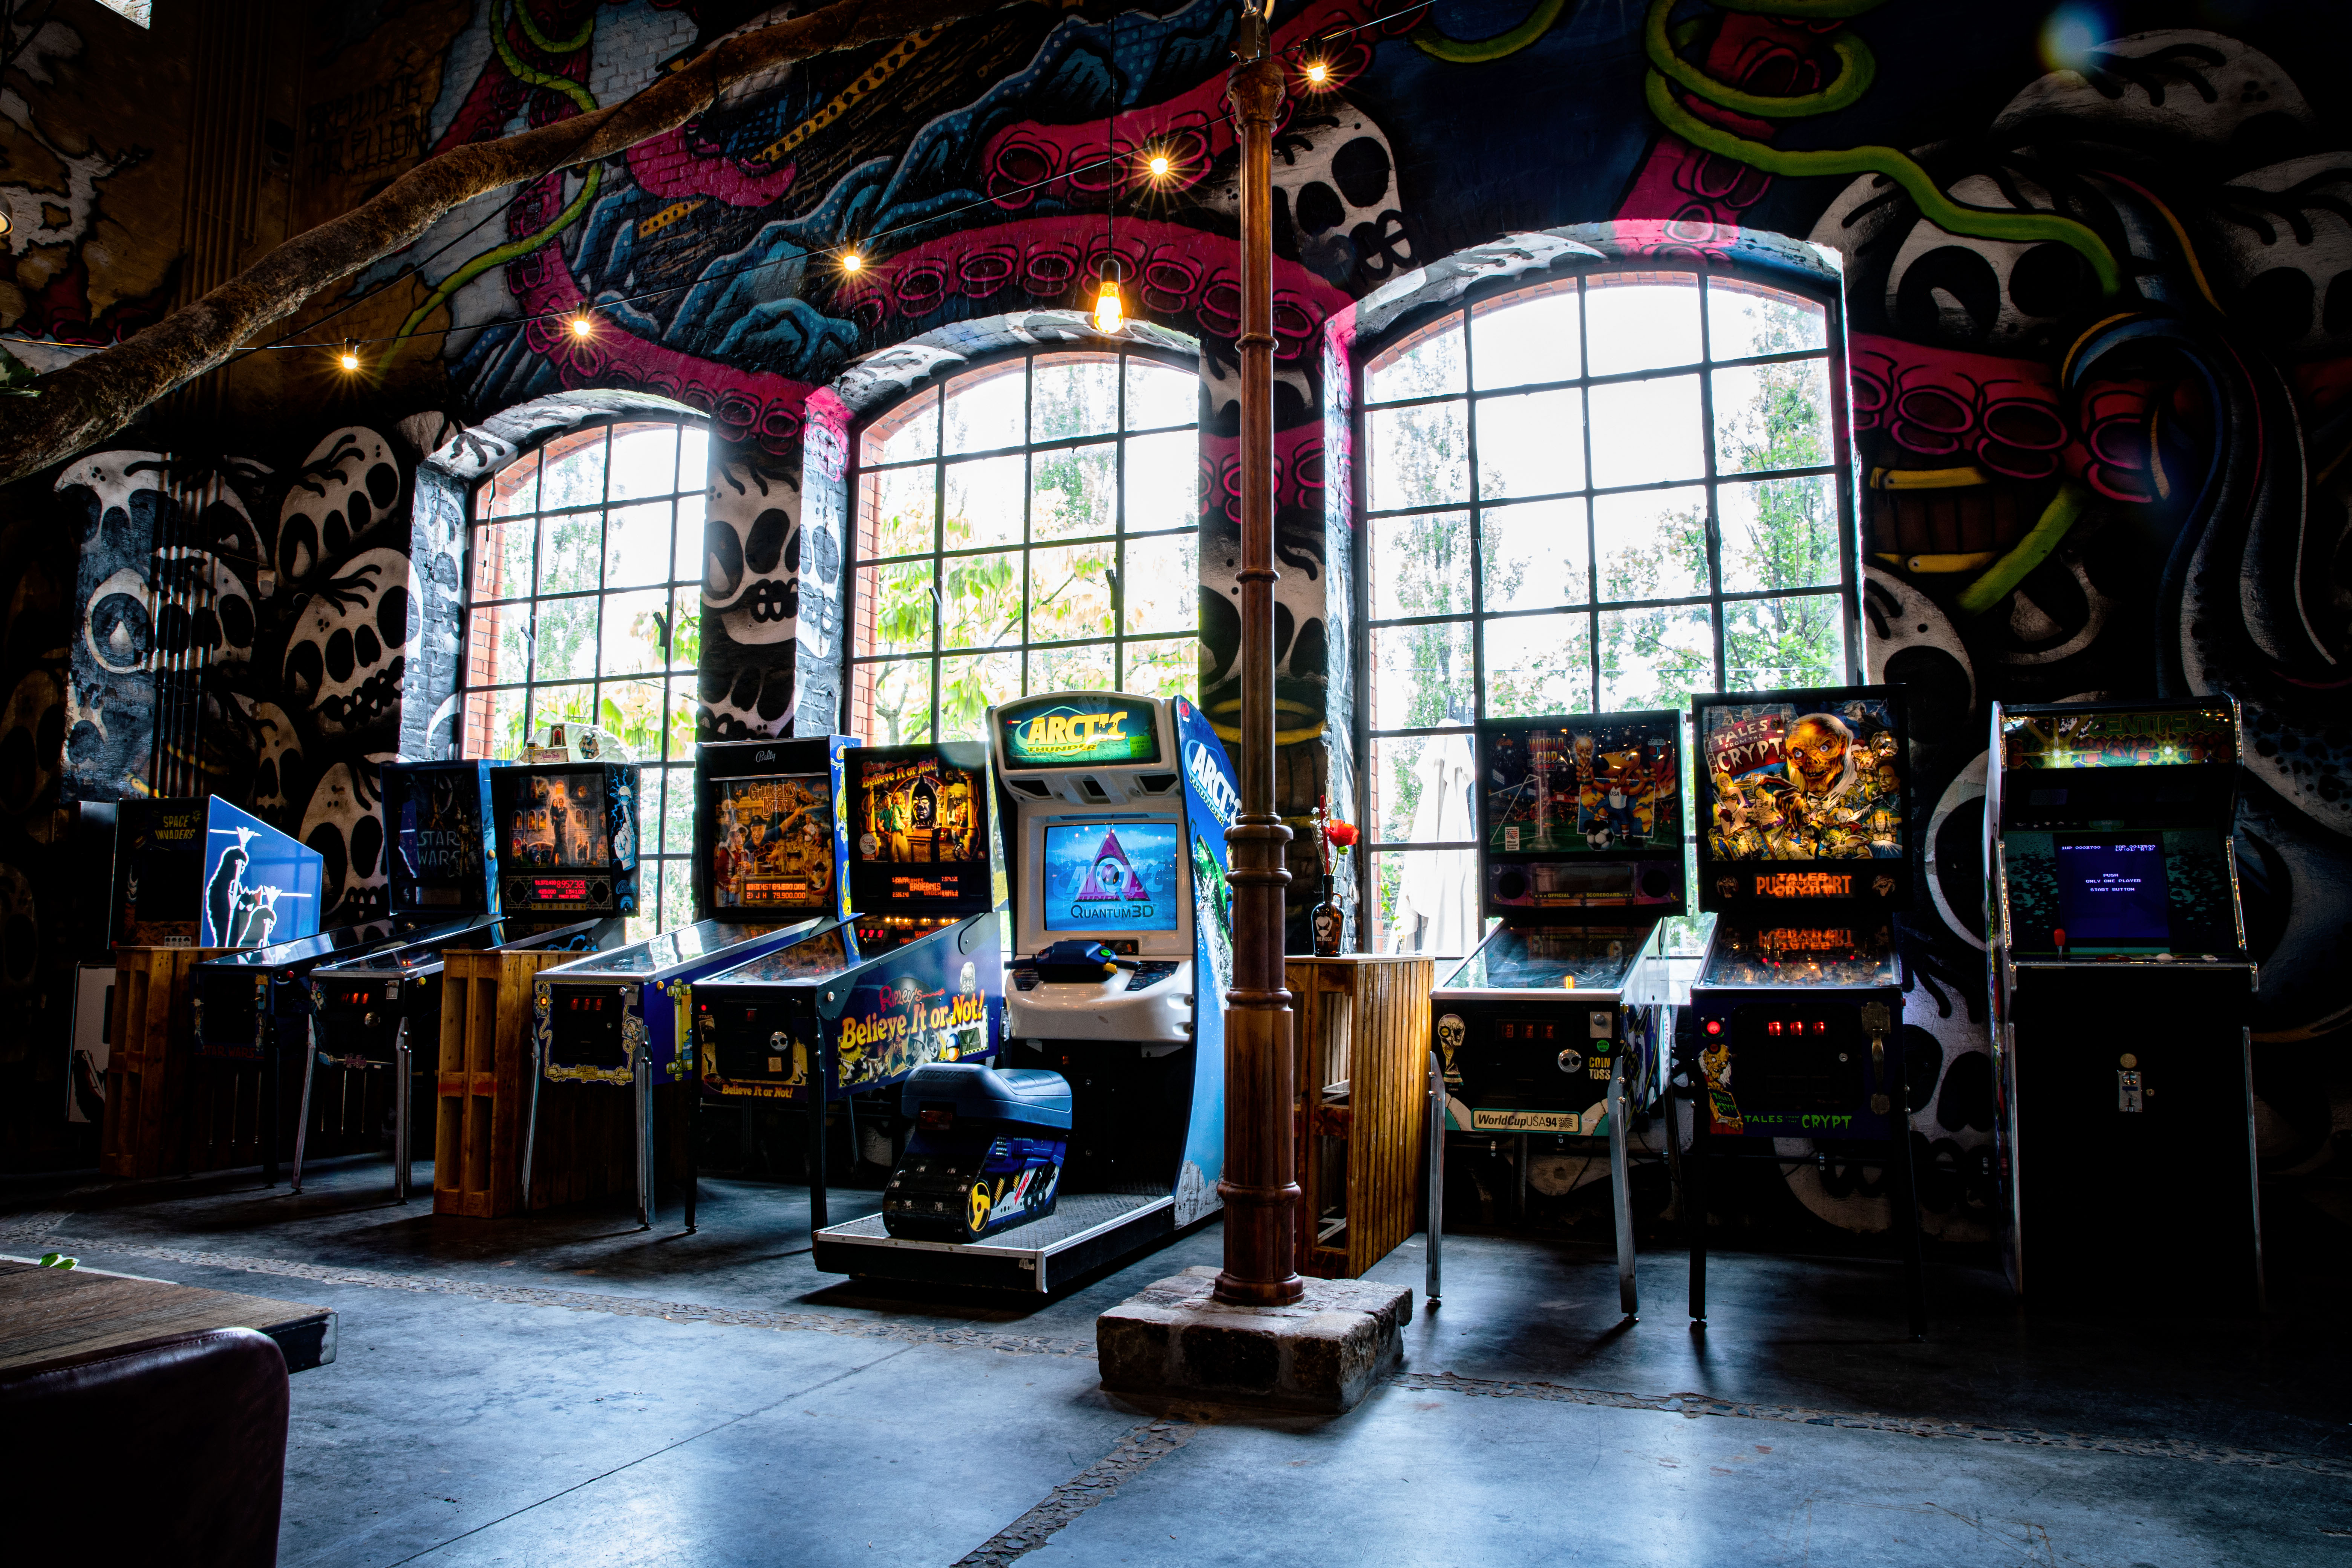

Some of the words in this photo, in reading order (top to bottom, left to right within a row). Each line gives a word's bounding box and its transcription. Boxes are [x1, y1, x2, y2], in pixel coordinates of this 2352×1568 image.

[1027, 712, 1128, 745] ARCTIC
[2089, 714, 2221, 735] CENTIPEDE
[1714, 720, 1768, 746] TALES
[1027, 744, 1097, 753] THUNDER
[1529, 737, 1565, 752] WORLD
[1725, 738, 1747, 749] FROM
[756, 750, 776, 763] Bally
[1536, 751, 1558, 769] CUP
[1717, 738, 1782, 771] CRYPT
[862, 773, 894, 788] Believe
[896, 767, 905, 780] It
[906, 766, 917, 776] or
[918, 757, 938, 774] Not!
[763, 797, 798, 819] ISLAND
[1189, 774, 1225, 827] THUNDER
[162, 815, 190, 828] SPACE
[155, 829, 196, 840] INVADERS
[417, 830, 461, 846] STAR
[1756, 876, 1796, 894] PUS
[1777, 873, 1828, 882] TALES
[616, 880, 639, 897] Bally
[840, 1012, 907, 1050] Believe
[911, 1003, 927, 1034] It
[931, 1006, 949, 1029] or
[951, 989, 985, 1025] Not!
[200, 1045, 227, 1057] STAR
[229, 1046, 257, 1059] WARS
[1589, 1057, 1610, 1068] COIN
[1589, 1069, 1611, 1080] TOSS
[722, 1084, 752, 1096] Believe
[754, 1086, 762, 1096] It
[774, 1087, 793, 1098] Not!
[1802, 1115, 1852, 1129] CRYPT
[1014, 1170, 1030, 1205] MIDWAY
